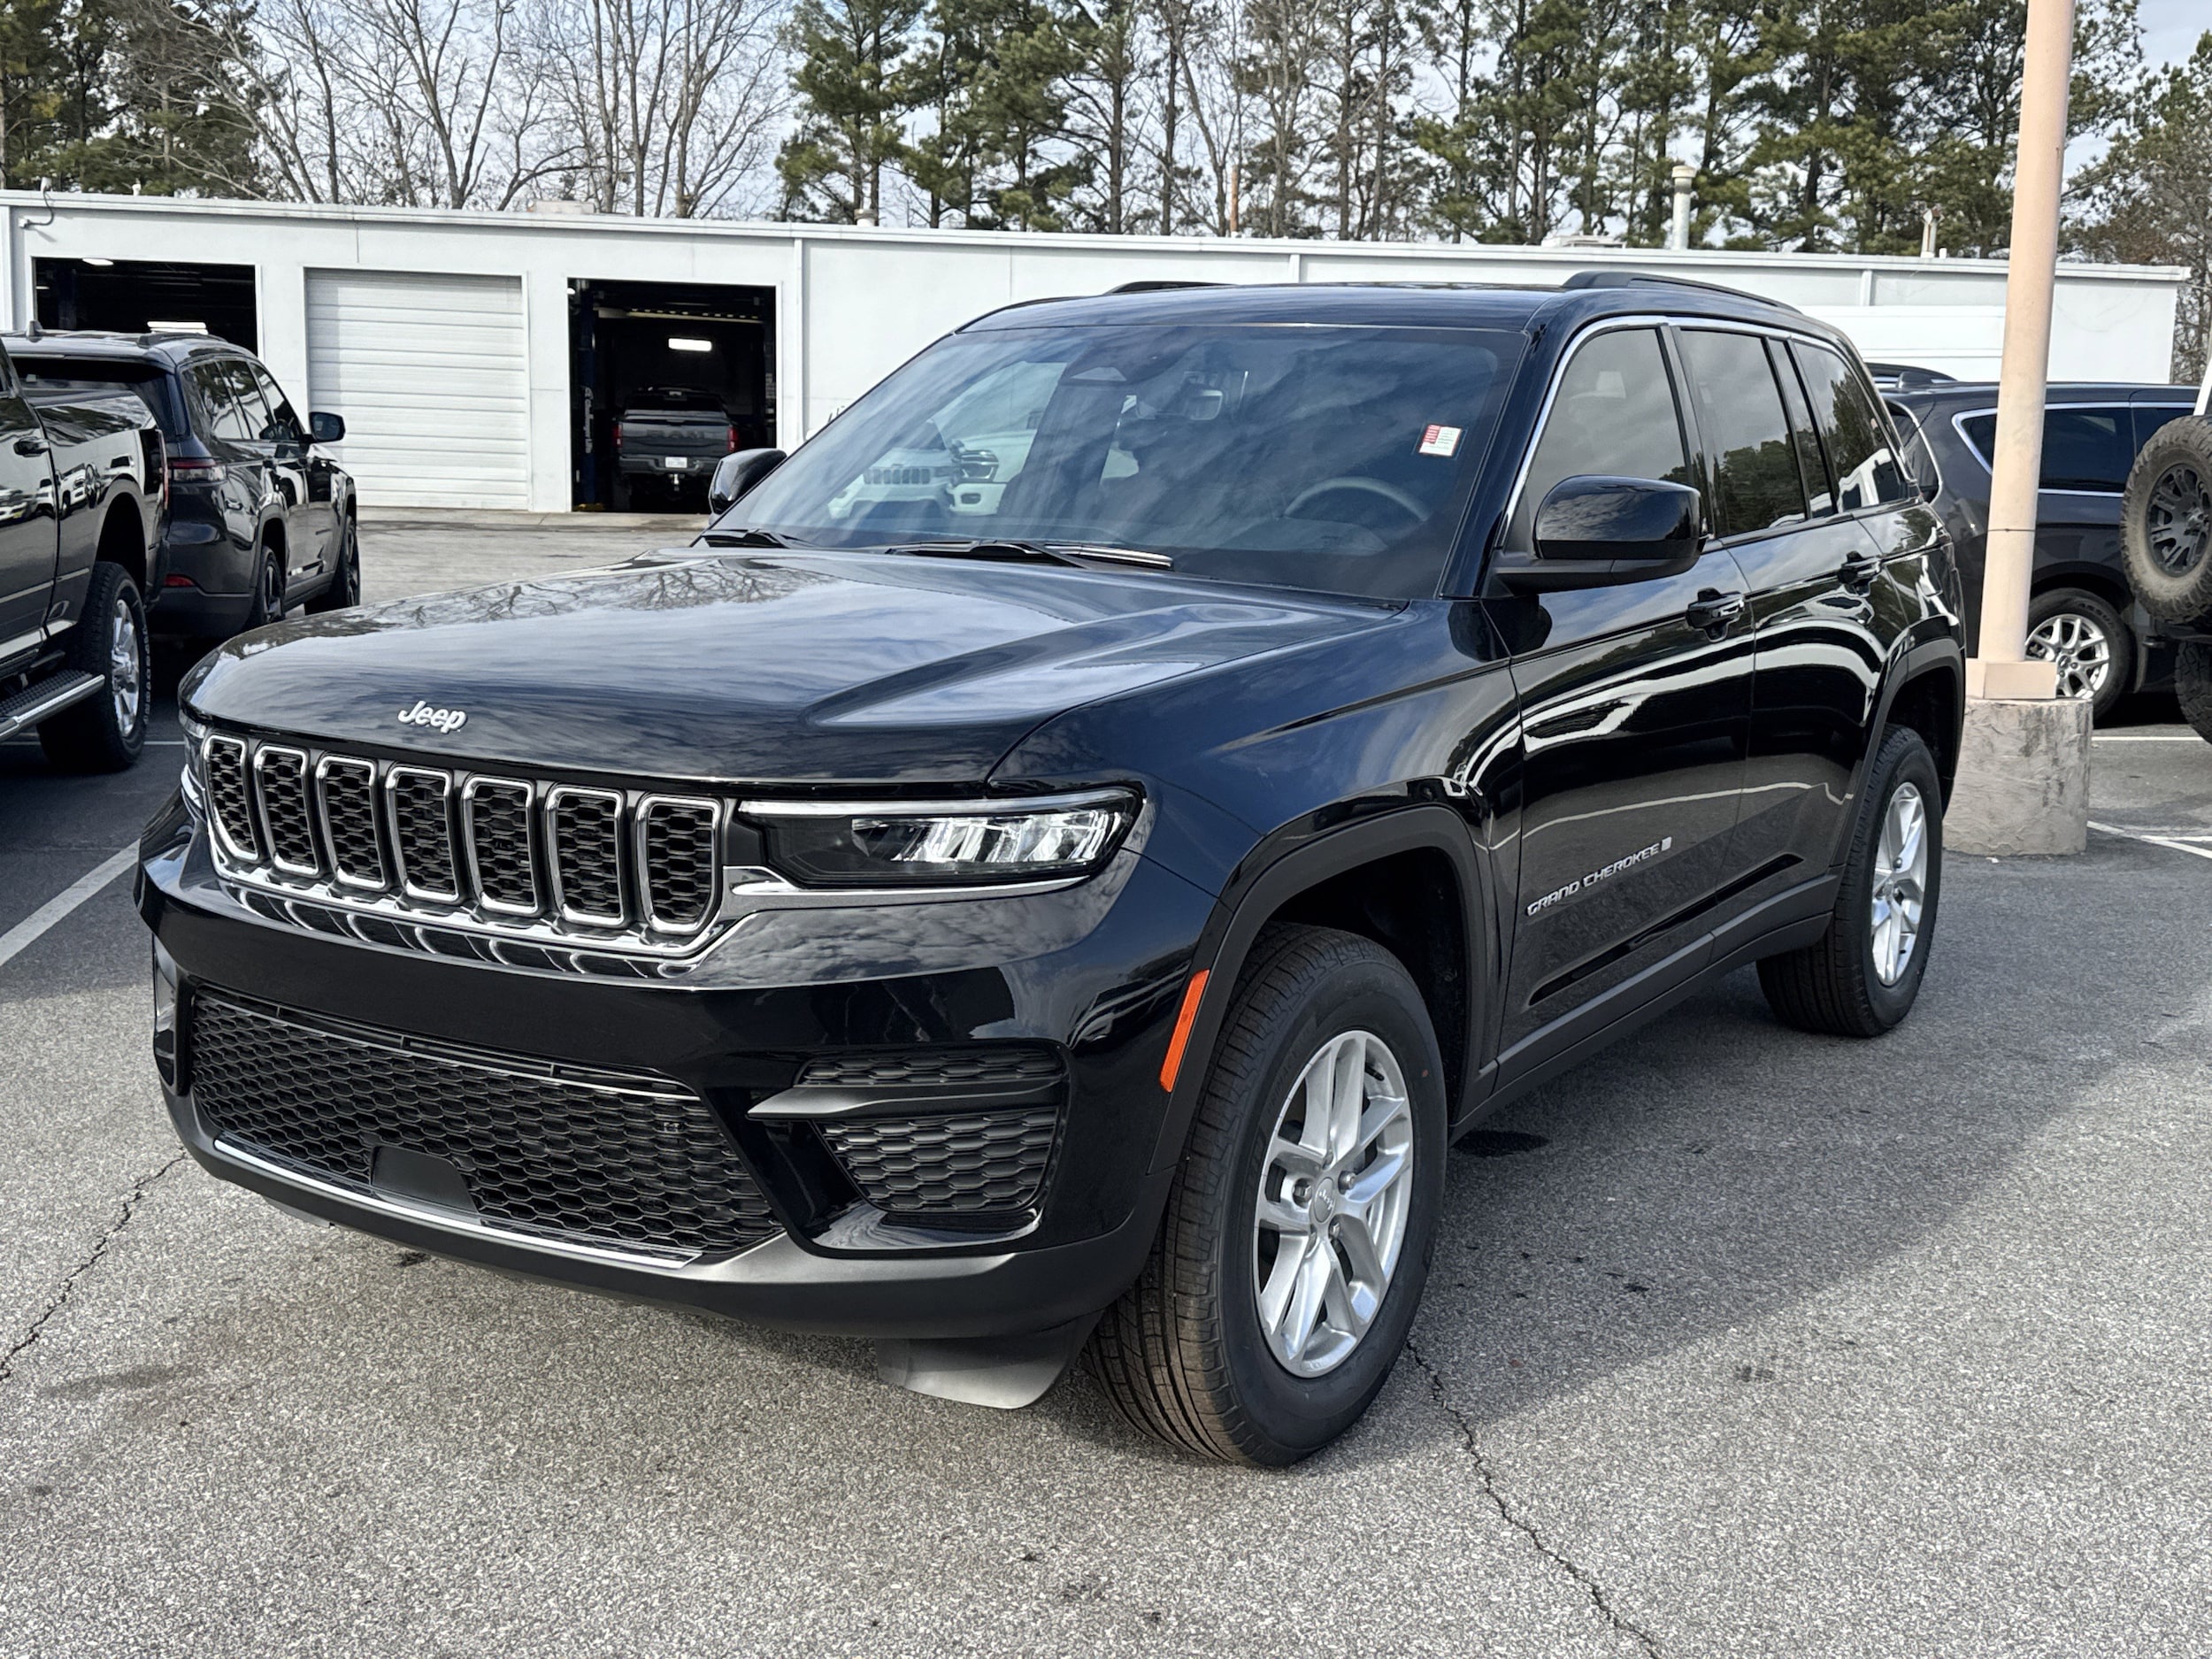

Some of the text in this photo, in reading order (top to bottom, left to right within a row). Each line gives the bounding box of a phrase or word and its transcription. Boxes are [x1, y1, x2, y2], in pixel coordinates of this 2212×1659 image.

[397, 700, 467, 733] Jeep
[1526, 842, 1660, 917] GRAND CHEROKEE
